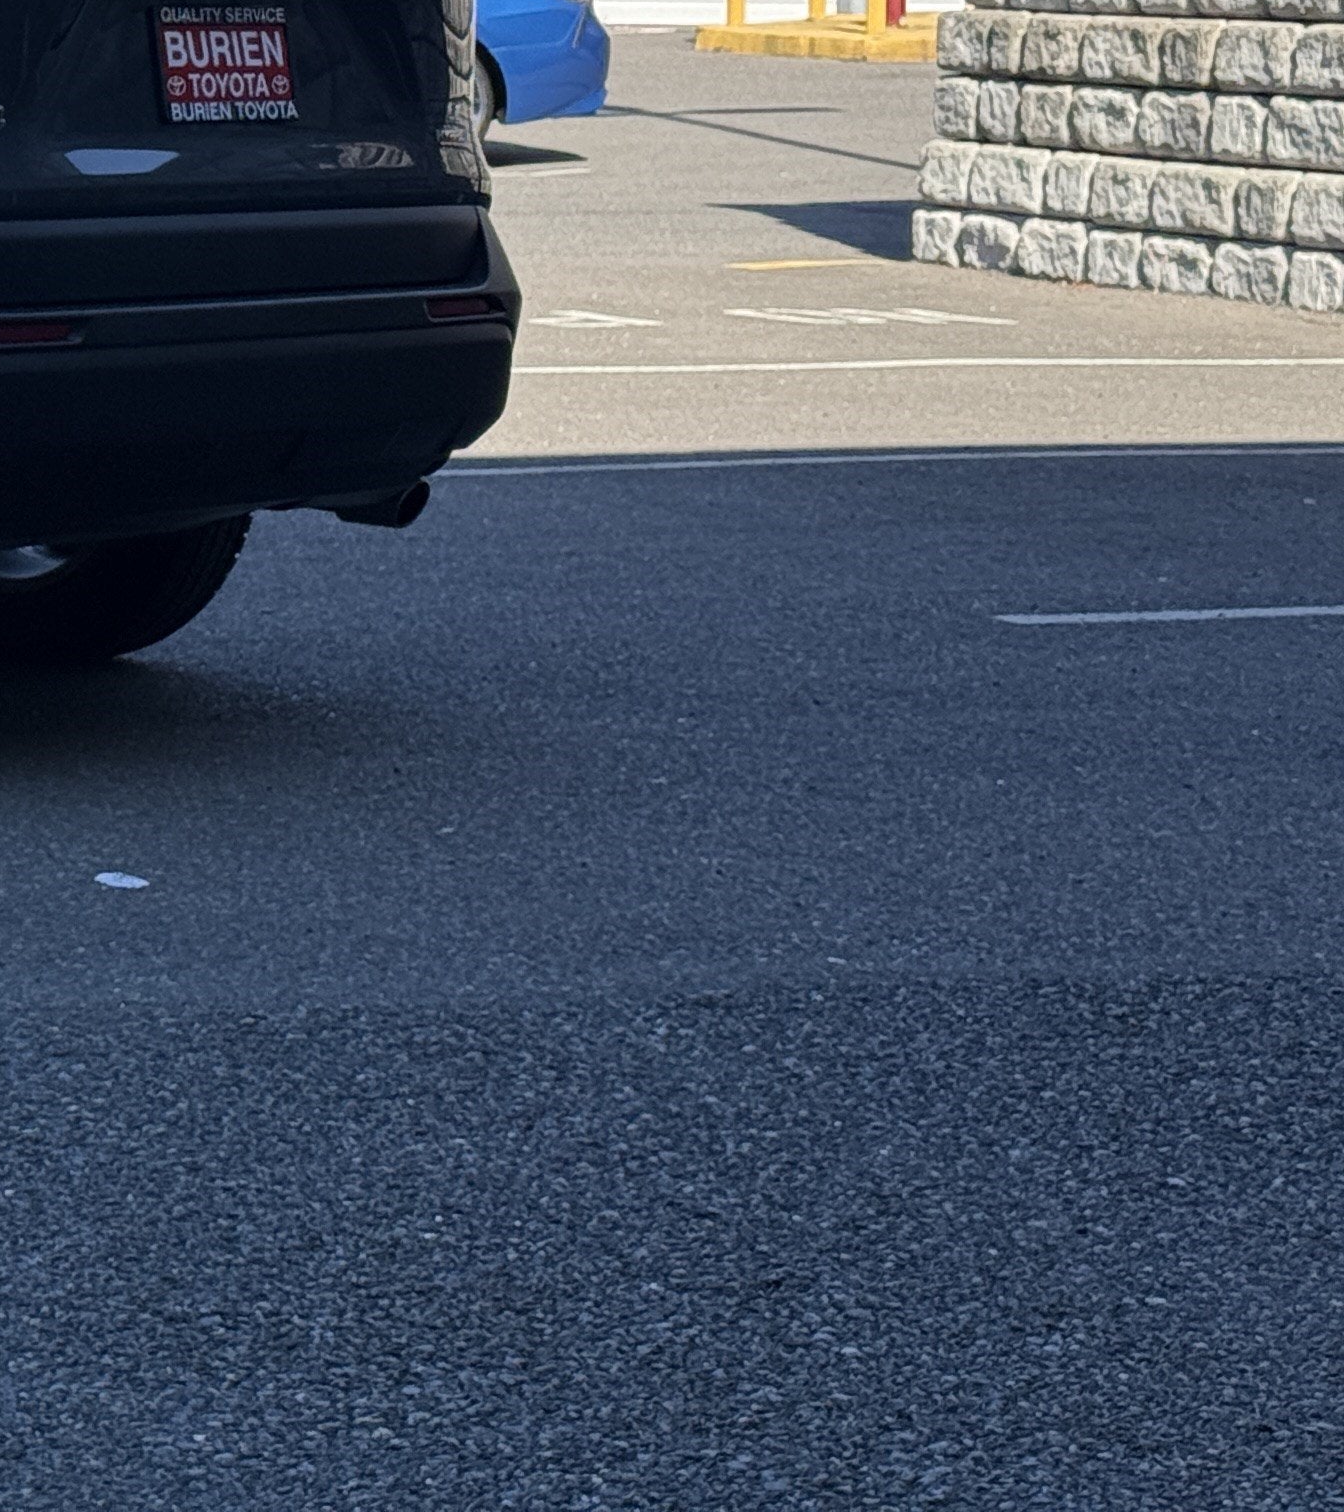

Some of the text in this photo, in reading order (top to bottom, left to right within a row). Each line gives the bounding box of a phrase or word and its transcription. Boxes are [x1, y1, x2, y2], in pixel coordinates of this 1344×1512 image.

[161, 7, 286, 22] QUALITY SERVICE
[164, 30, 285, 68] BURIEN
[188, 72, 270, 98] TOYOTA
[171, 100, 299, 122] BURIEN TOYOTA
